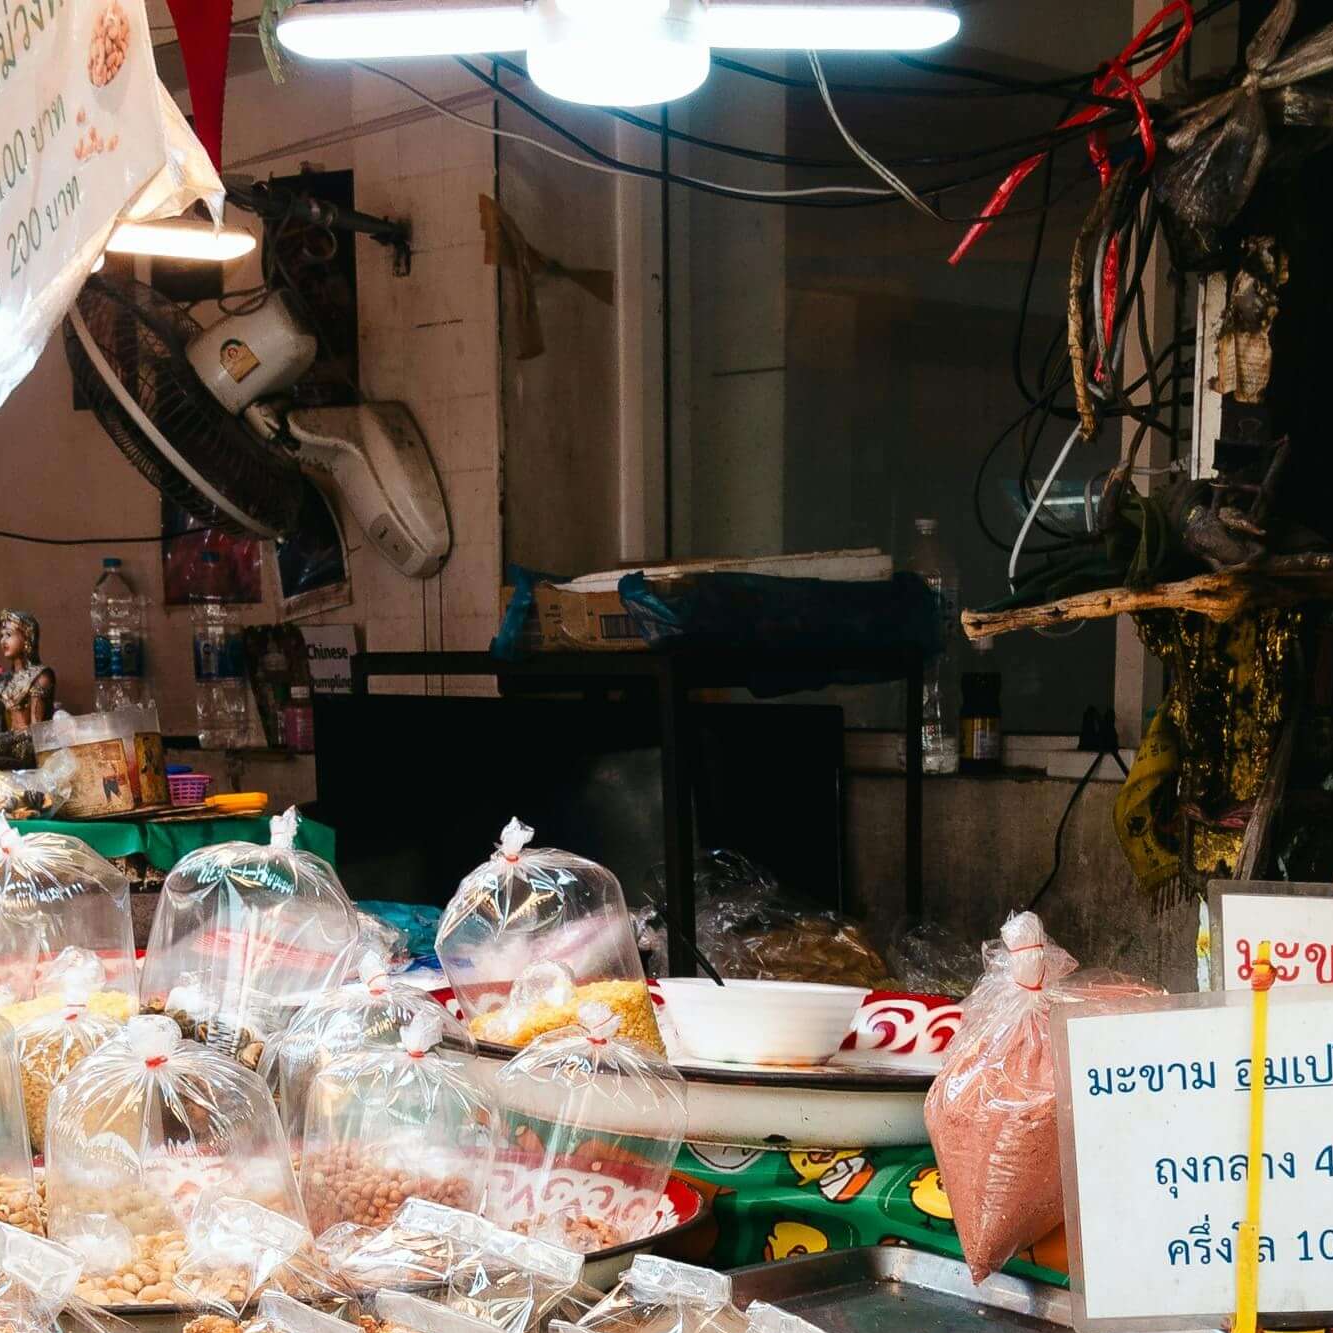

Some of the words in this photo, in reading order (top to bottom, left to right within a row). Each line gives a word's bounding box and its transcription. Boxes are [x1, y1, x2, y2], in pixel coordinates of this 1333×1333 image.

[30, 93, 67, 154] บาท
[6, 207, 43, 278] 200
[44, 175, 82, 232] บาท
[307, 644, 349, 660] Chinese
[313, 674, 354, 693] umpling
[1087, 1055, 1217, 1098] มะขาม
[1168, 1214, 1277, 1268] ครึ่งล
